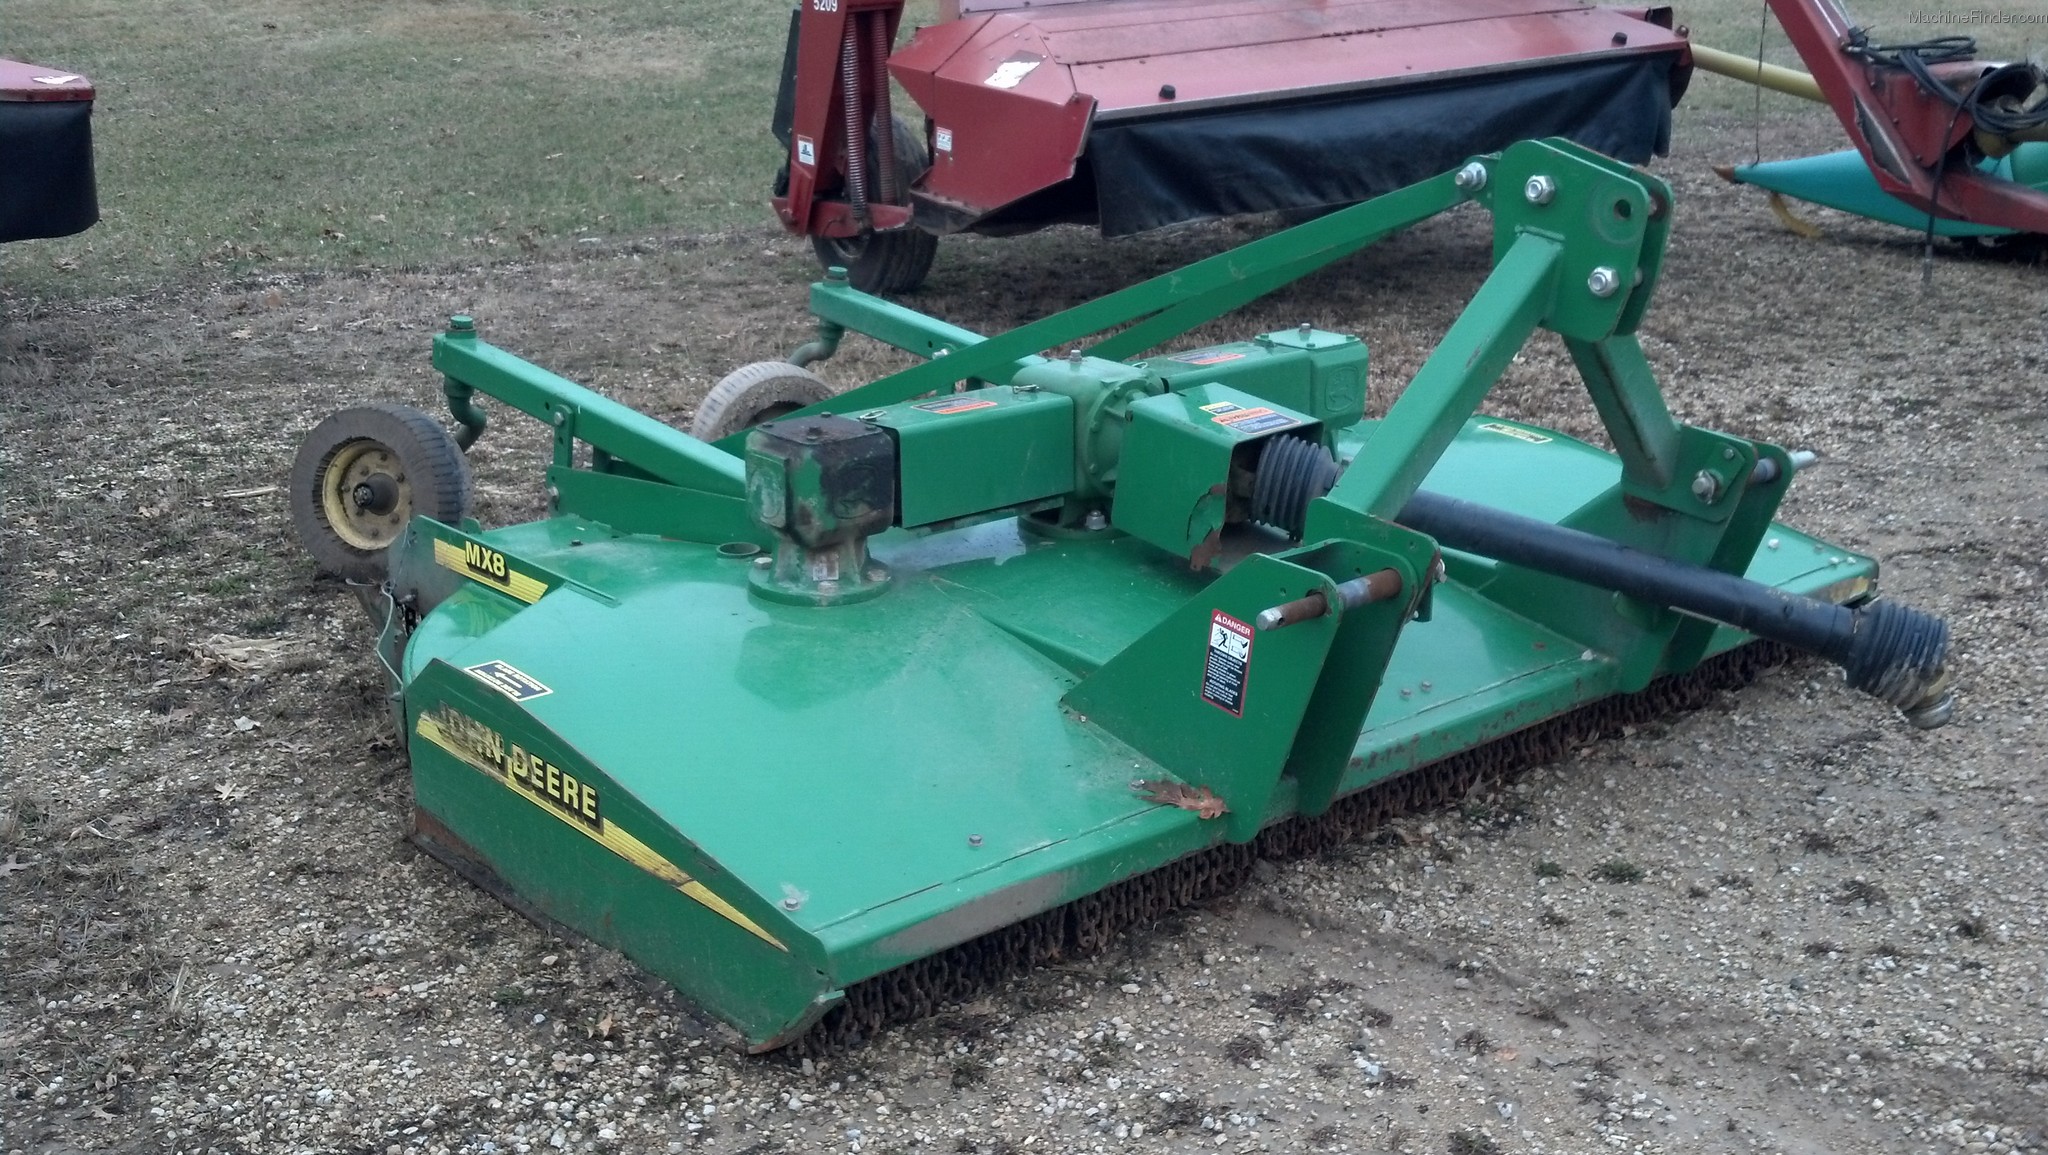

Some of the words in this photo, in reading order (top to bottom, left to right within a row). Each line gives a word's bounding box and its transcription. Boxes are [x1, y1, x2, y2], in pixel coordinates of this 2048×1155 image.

[813, 0, 838, 12] 5209
[465, 540, 507, 579] MX8
[1222, 616, 1251, 636] DANGER
[511, 743, 599, 823] DEERE
